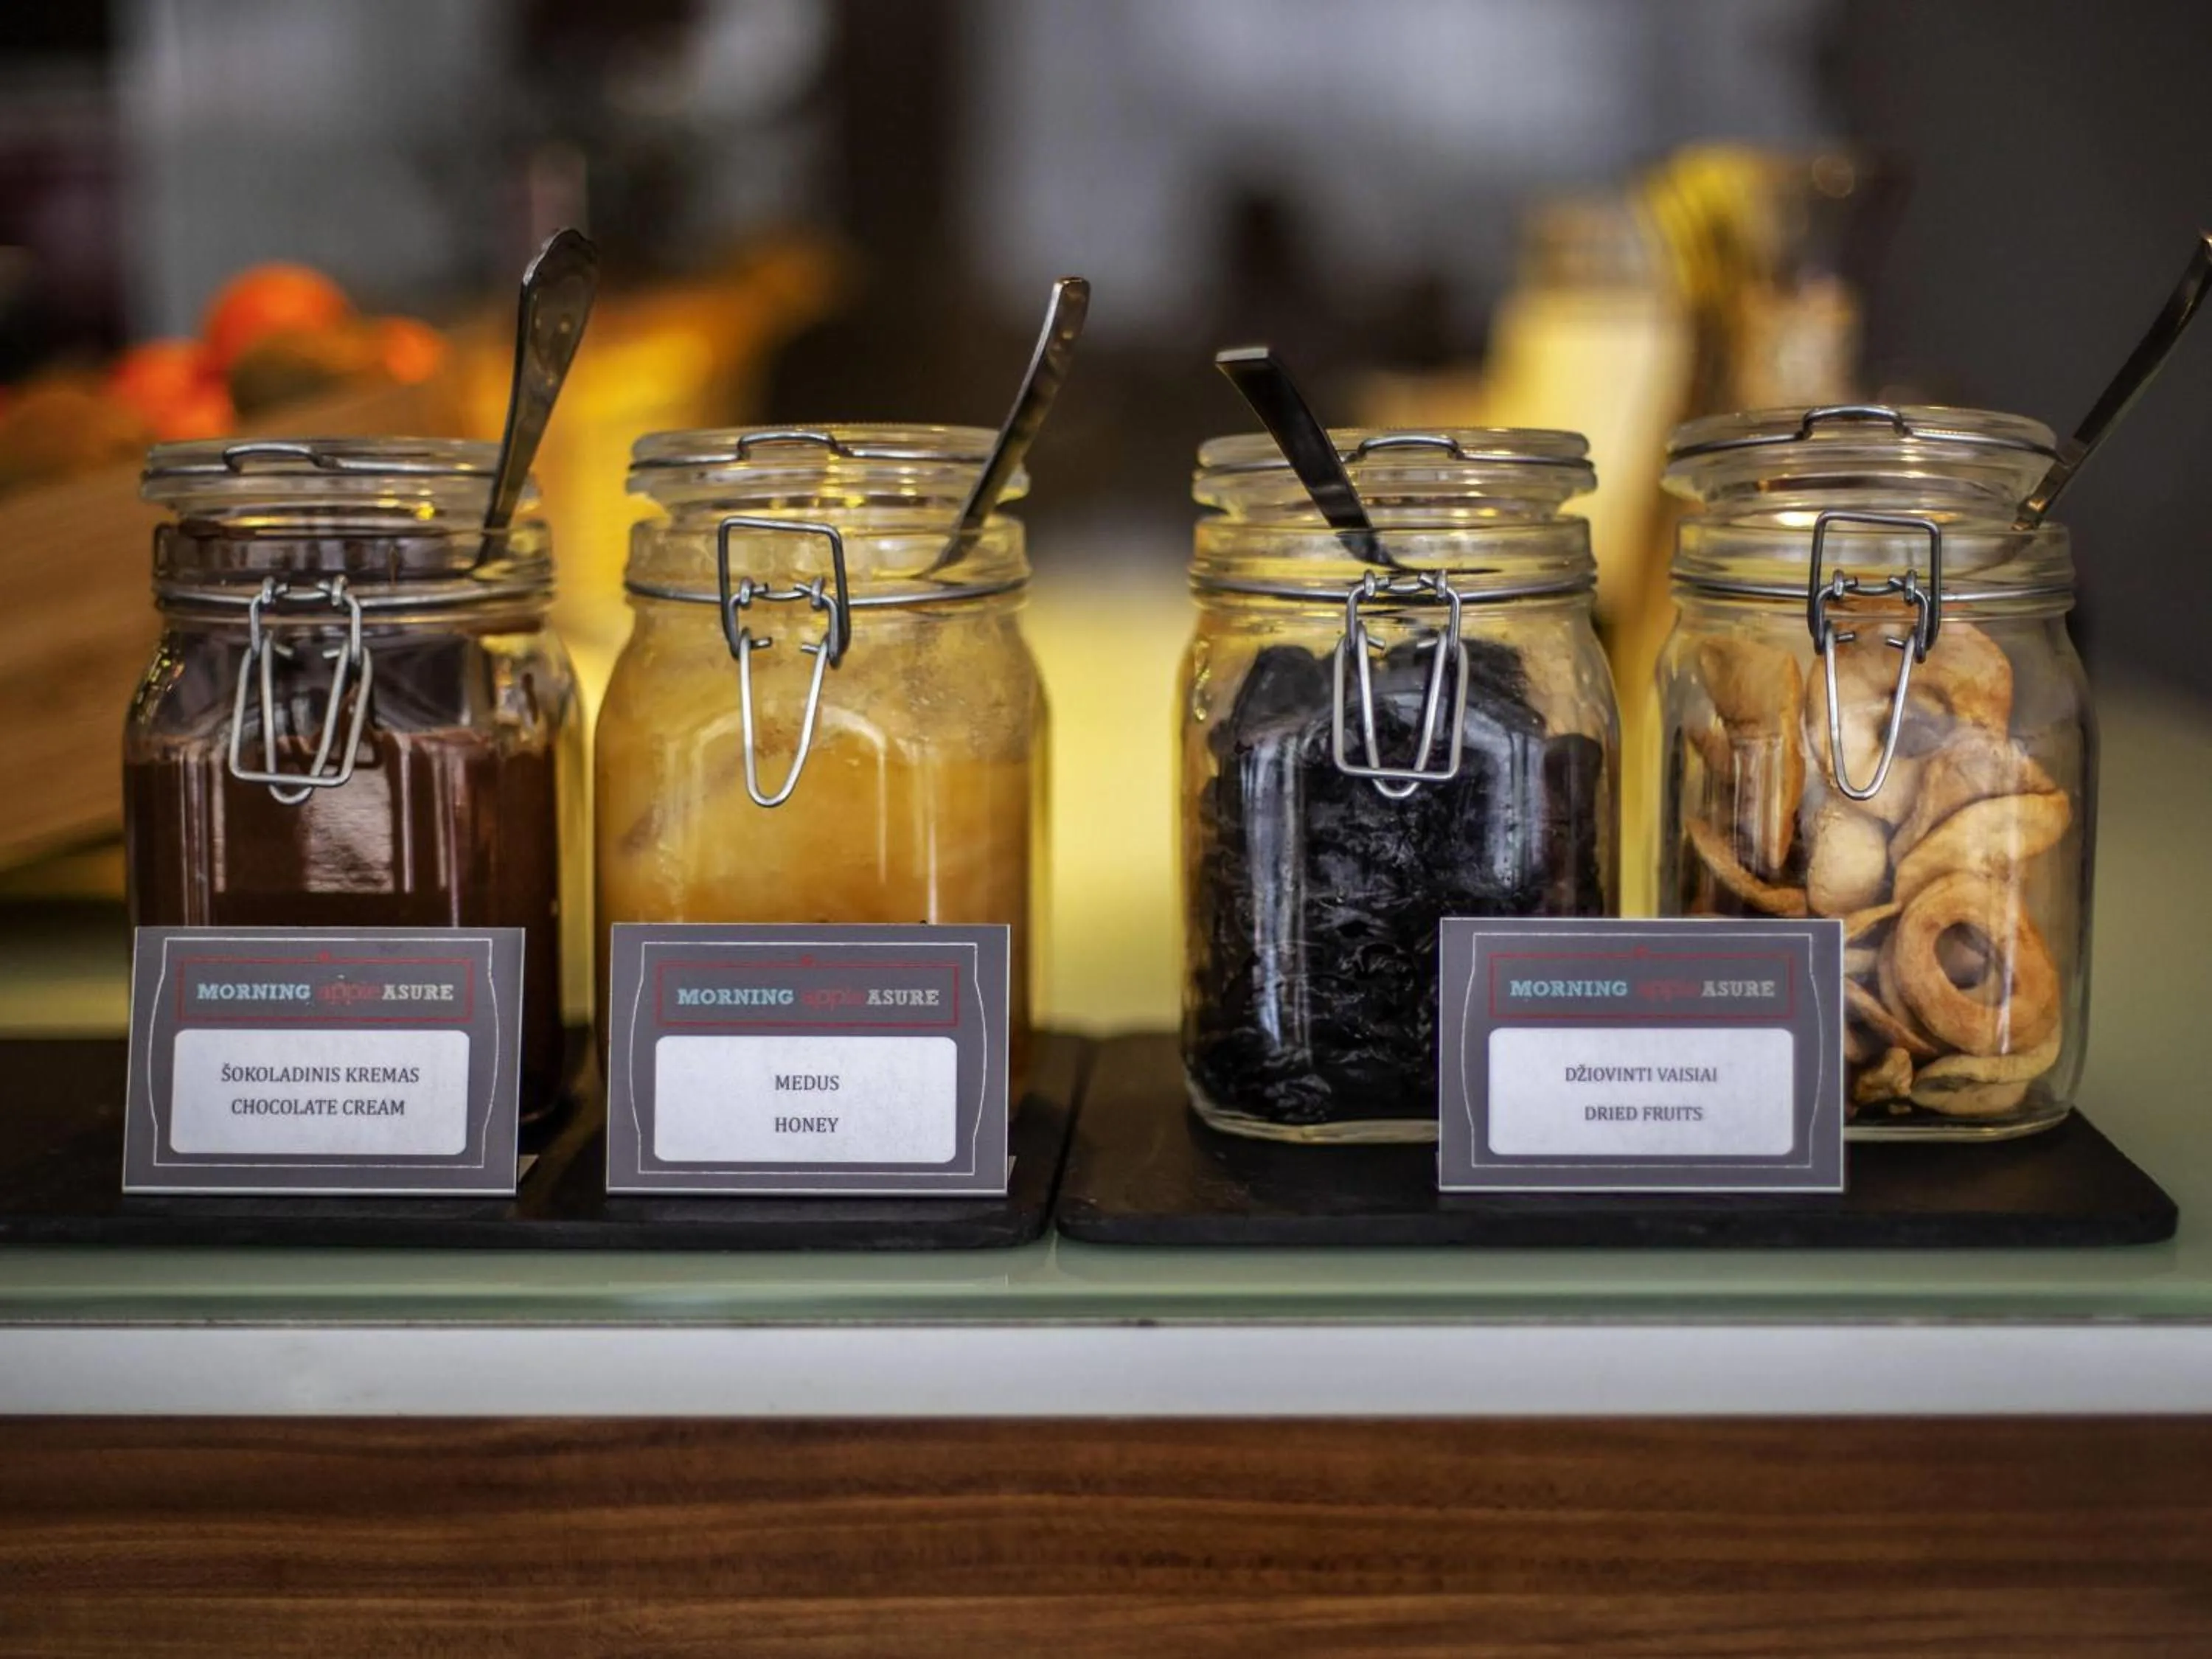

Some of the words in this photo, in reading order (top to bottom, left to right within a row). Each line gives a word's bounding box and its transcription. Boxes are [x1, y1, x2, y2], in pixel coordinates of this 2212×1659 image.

[198, 982, 310, 1001] MORNING
[381, 983, 454, 1001] ASURE
[677, 988, 794, 1006] MORNING
[866, 988, 940, 1006] ASURE
[1509, 978, 1628, 998] MORNING
[1701, 979, 1775, 998] ASURE
[220, 1062, 341, 1083] ŠOKOLADINIS
[345, 1066, 420, 1084] KREMAS
[1565, 1063, 1652, 1082] DŽIOVINTI
[1657, 1066, 1718, 1083] VAISIAI
[774, 1074, 840, 1091] MEDUS
[230, 1099, 338, 1116] CHOCOLATE
[341, 1099, 406, 1116] CREAM
[1585, 1105, 1638, 1121] DRIED
[1642, 1105, 1703, 1121] FRUITS
[774, 1116, 839, 1134] HONEY
